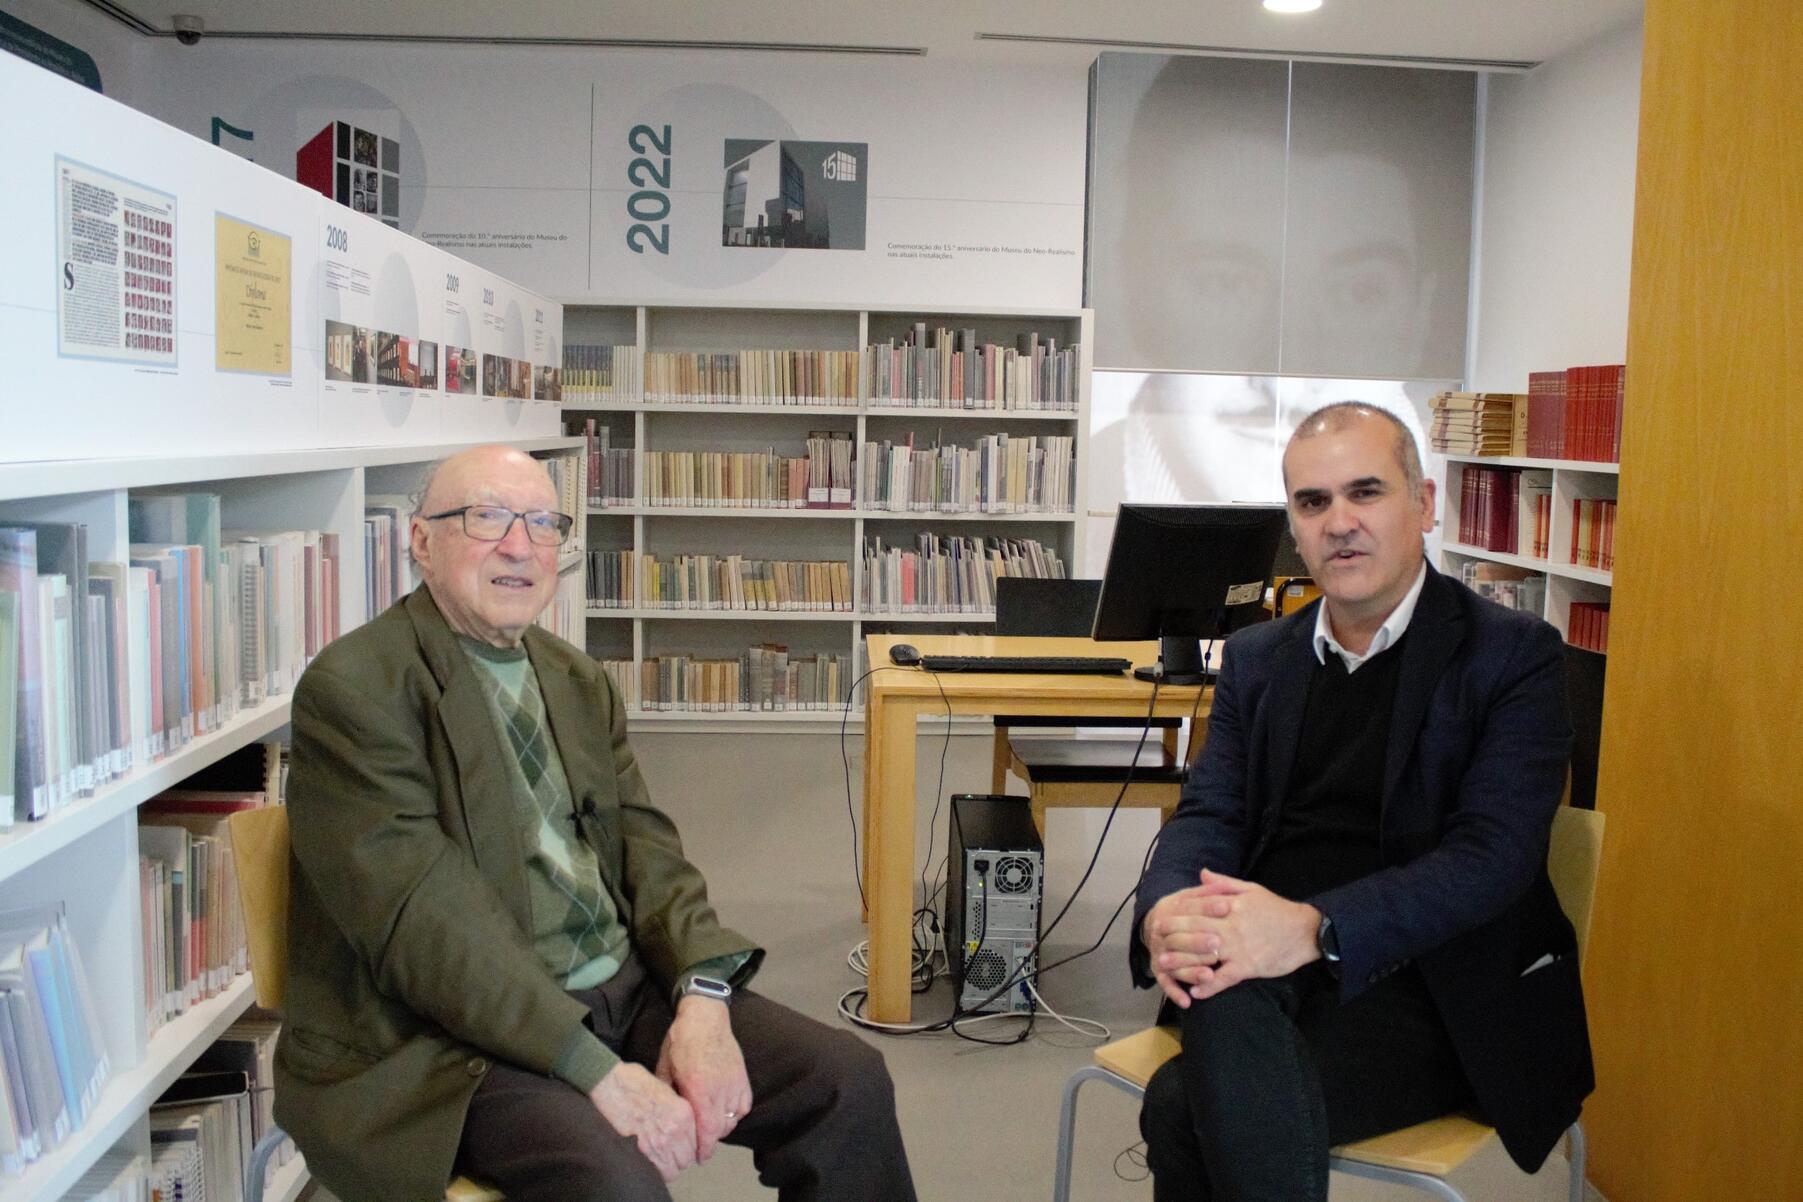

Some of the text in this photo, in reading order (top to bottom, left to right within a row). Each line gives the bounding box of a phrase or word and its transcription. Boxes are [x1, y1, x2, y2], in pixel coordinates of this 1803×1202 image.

[822, 152, 837, 180] 15
[626, 124, 672, 255] 2022
[326, 224, 348, 253] 2008
[536, 233, 558, 241] Museu
[446, 273, 460, 294] 2009
